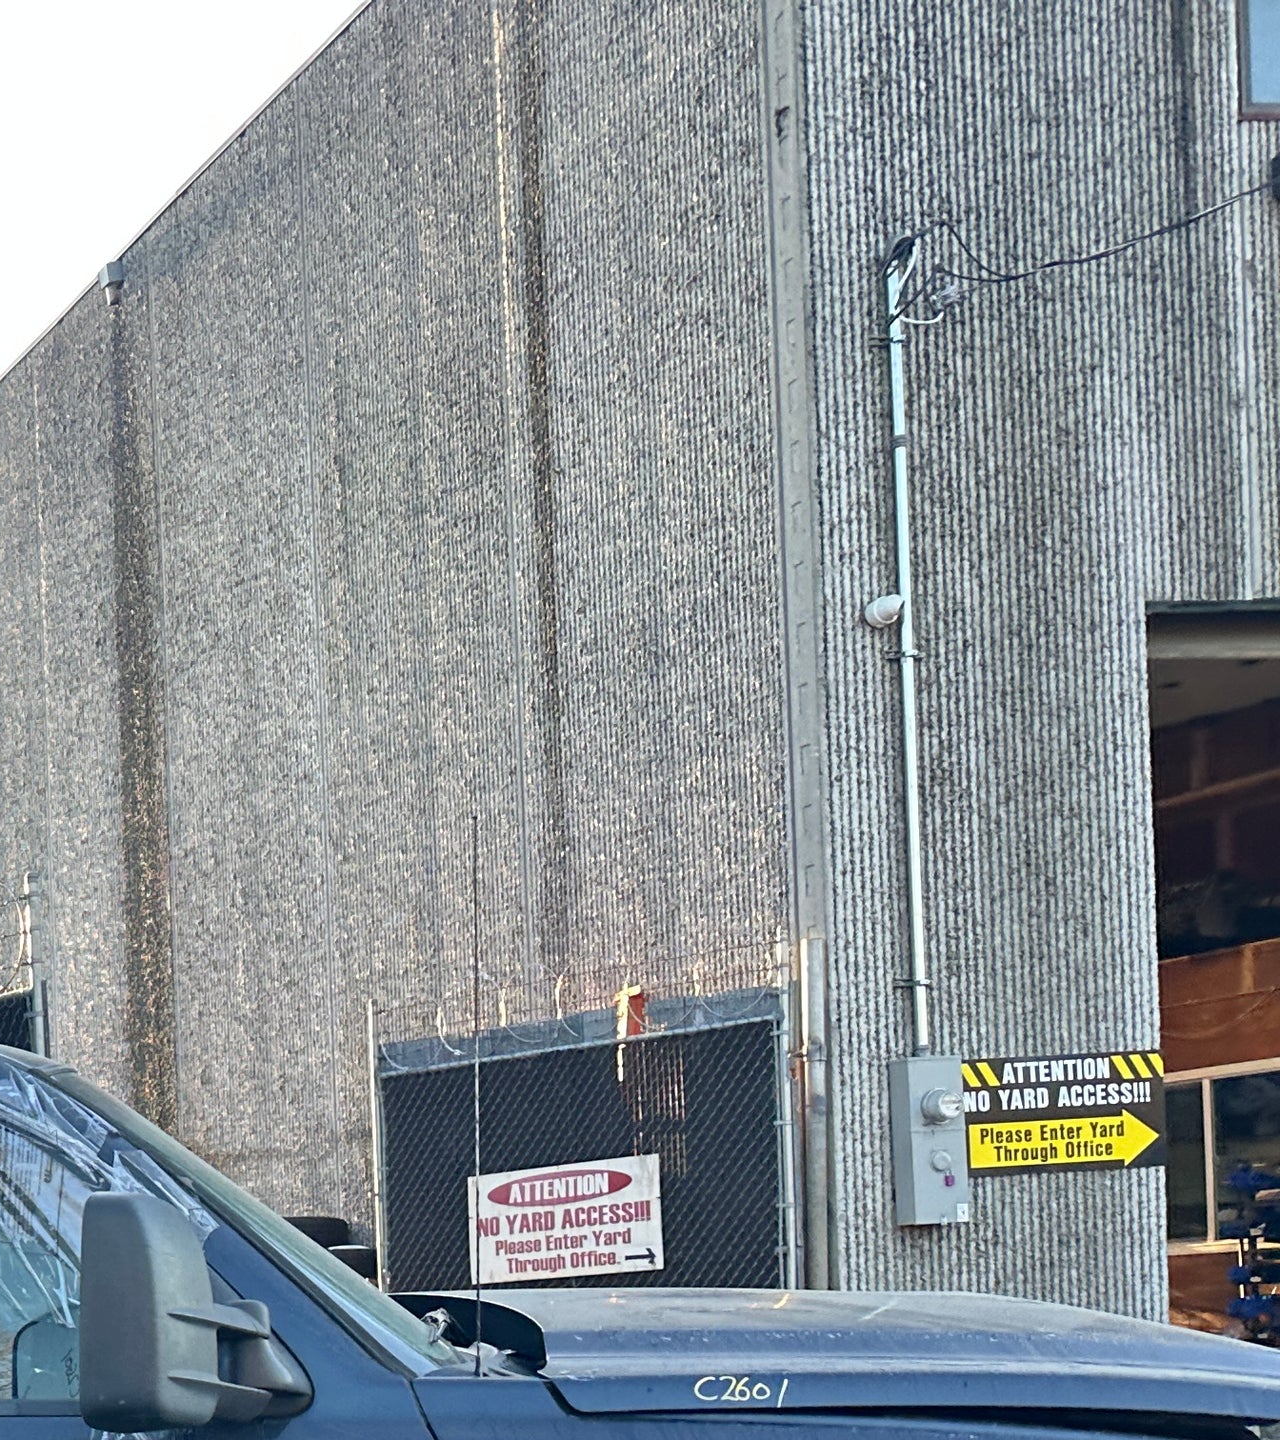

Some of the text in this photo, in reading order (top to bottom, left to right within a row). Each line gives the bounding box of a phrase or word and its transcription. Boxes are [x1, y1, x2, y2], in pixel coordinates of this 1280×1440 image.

[1002, 1058, 1110, 1085] ATTENTION
[964, 1082, 1151, 1112] NO YARD ACCESS!!!
[980, 1121, 1125, 1145] Please Enter Yard
[993, 1140, 1113, 1163] Through Office
[509, 1172, 609, 1204] ATTENTION
[477, 1200, 651, 1237] NO YARD ACCESS!!!
[495, 1228, 631, 1256] Please Enter Yard
[507, 1257, 565, 1274] Through
[694, 1375, 789, 1408] C2601
